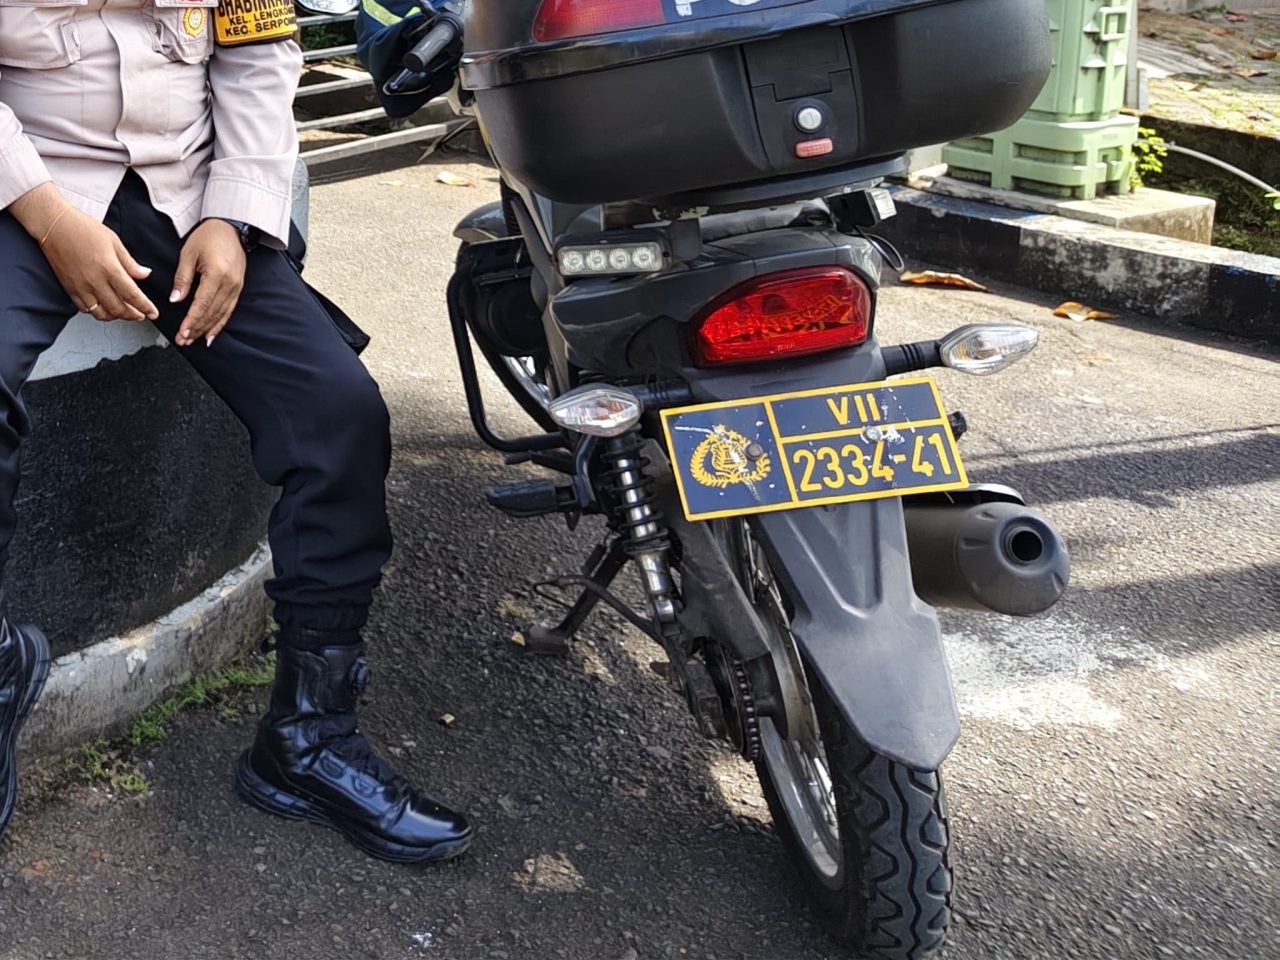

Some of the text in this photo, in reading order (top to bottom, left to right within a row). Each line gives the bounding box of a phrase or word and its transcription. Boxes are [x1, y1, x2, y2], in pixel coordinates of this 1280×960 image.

[225, 24, 252, 37] KEC.
[228, 14, 251, 27] KEL.
[826, 393, 881, 426] VII
[793, 432, 952, 493] 2334-41
